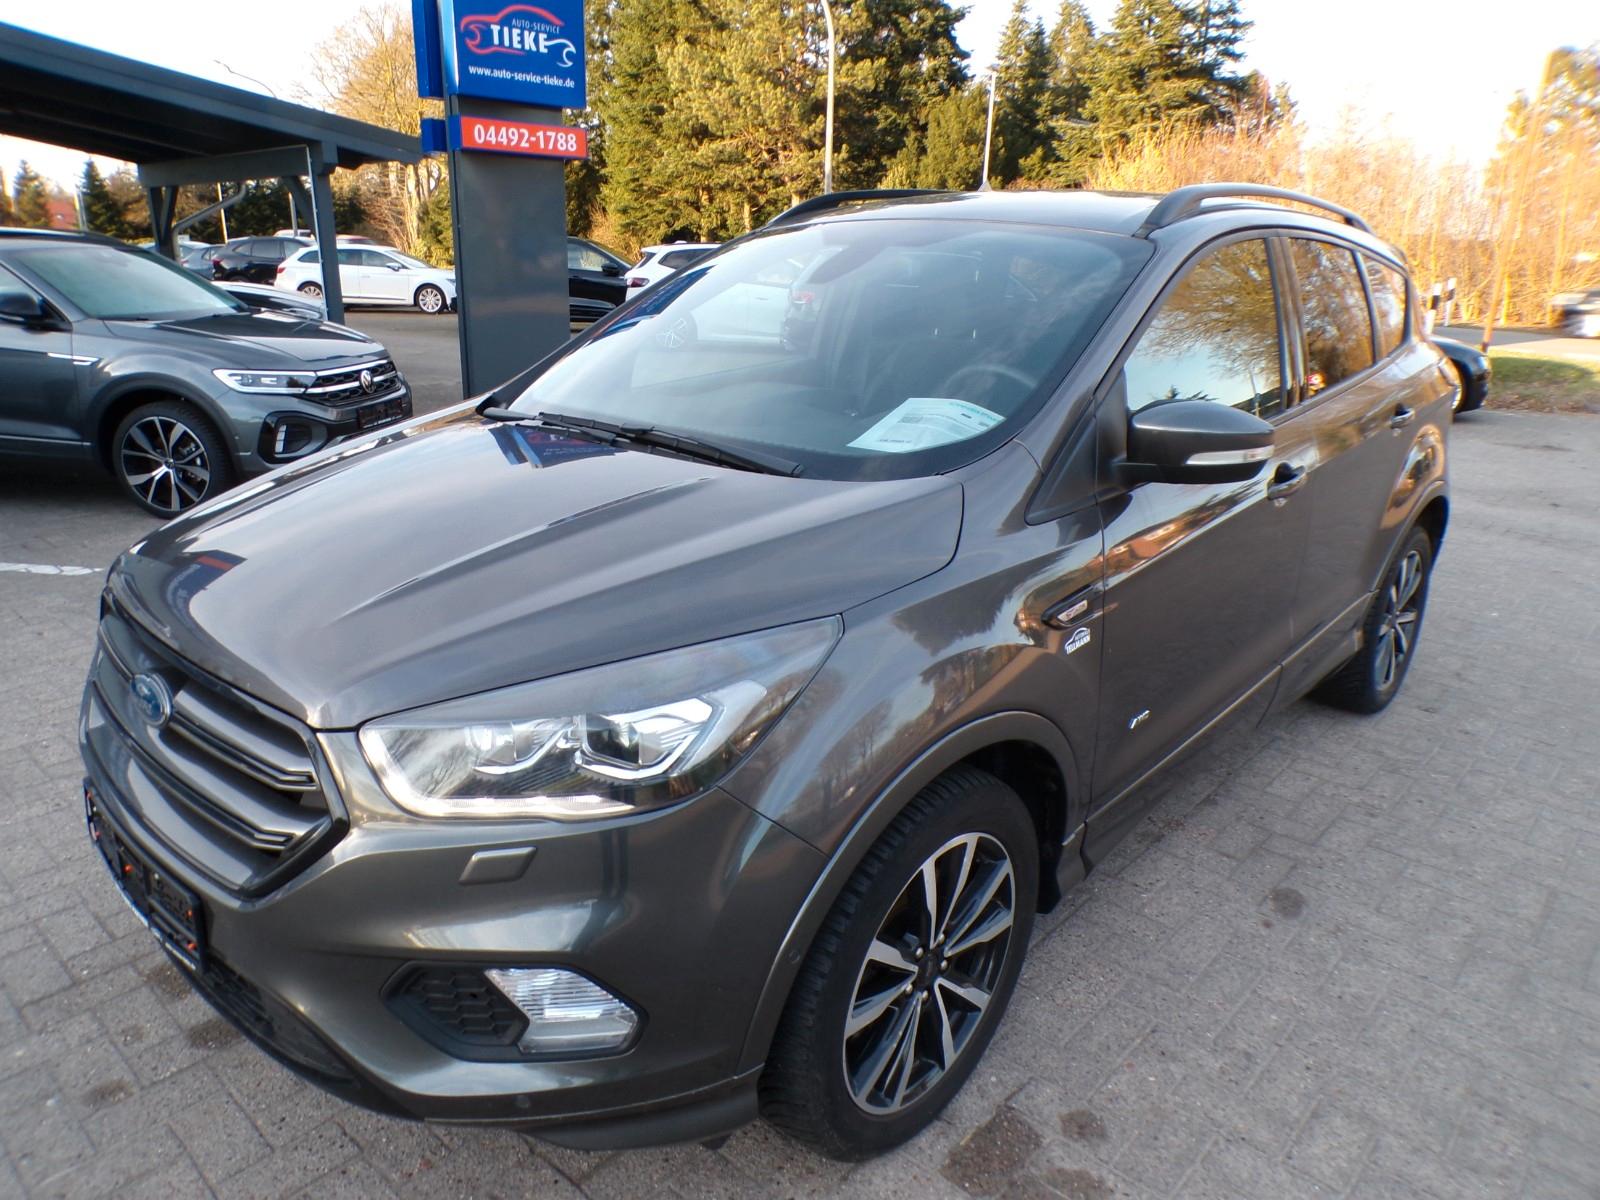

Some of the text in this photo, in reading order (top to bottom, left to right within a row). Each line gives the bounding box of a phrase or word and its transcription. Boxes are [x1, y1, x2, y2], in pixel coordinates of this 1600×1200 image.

[490, 24, 549, 54] TIEKE
[511, 18, 560, 34] AUTO-SERVICE
[468, 64, 575, 89] www.auto-service-tieke.de
[473, 124, 577, 152] 04492-1788
